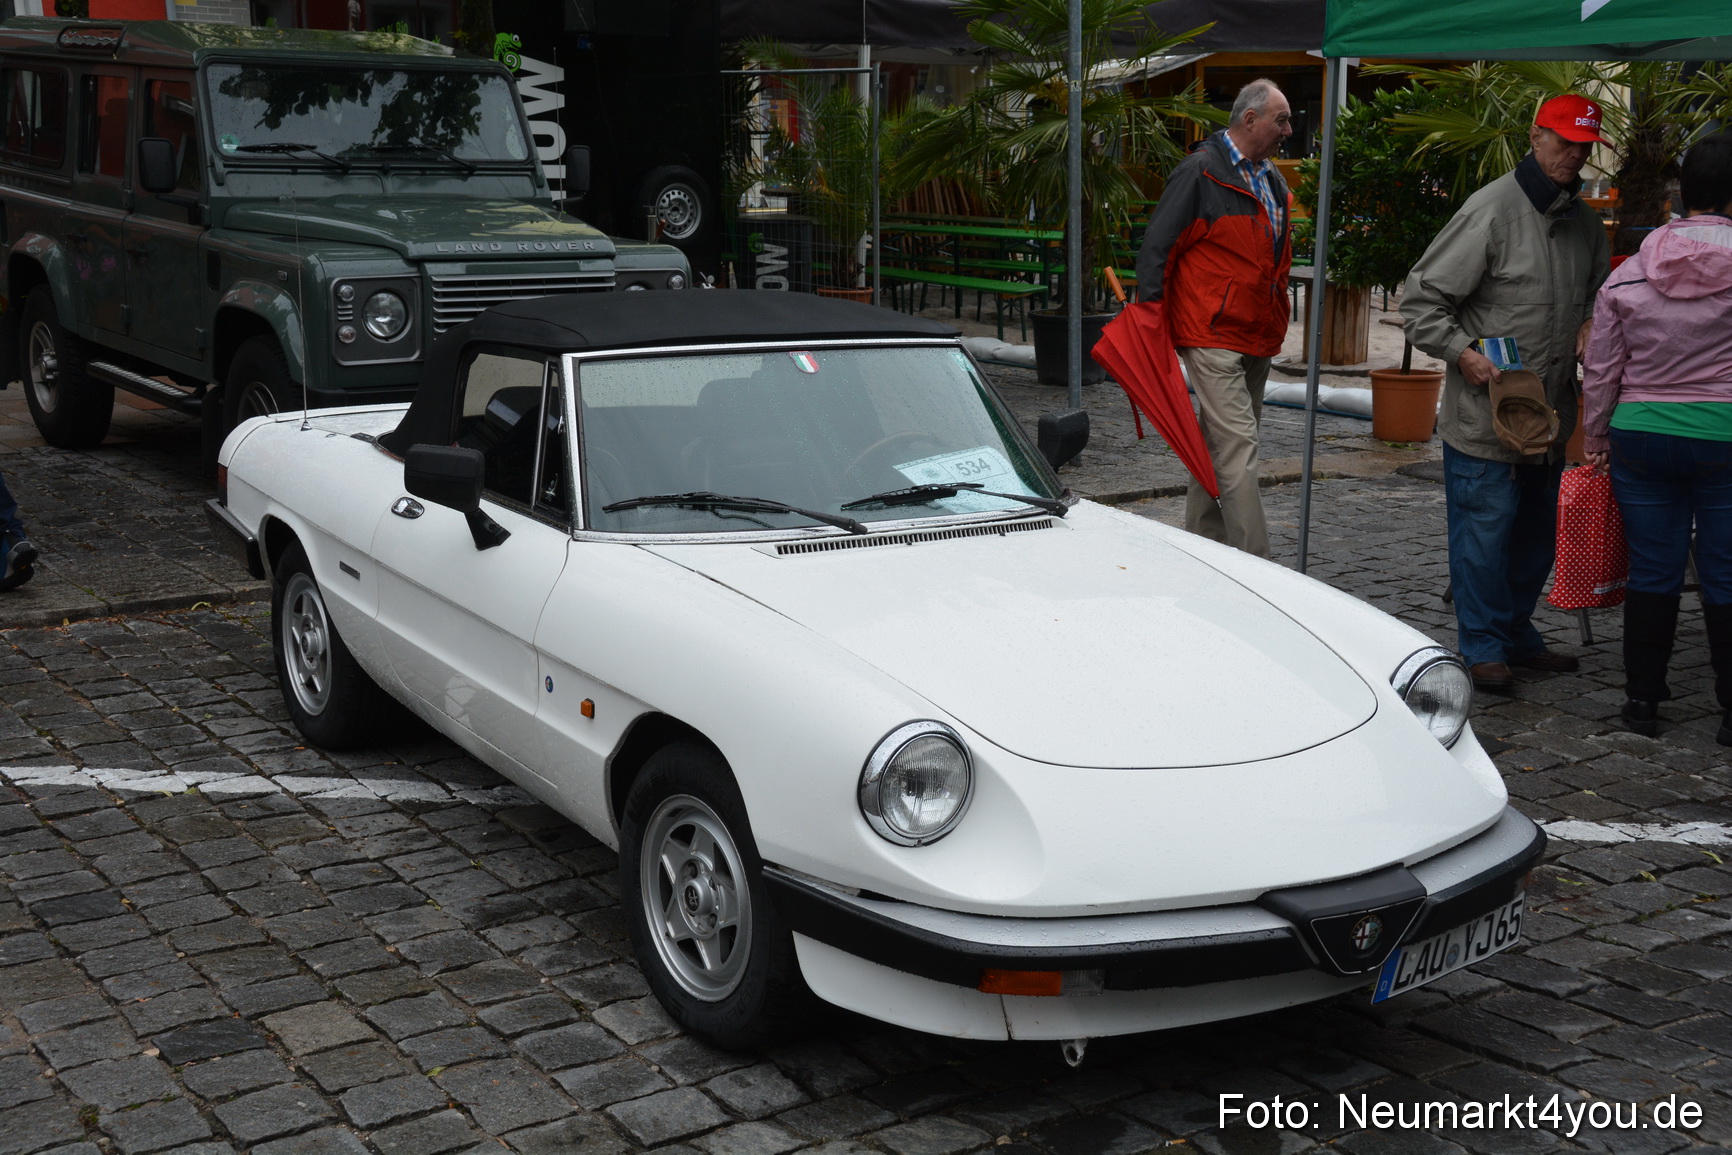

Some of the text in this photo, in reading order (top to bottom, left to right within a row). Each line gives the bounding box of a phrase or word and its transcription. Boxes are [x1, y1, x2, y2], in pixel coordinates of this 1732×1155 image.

[435, 240, 596, 253] LAND ROVER
[955, 457, 991, 477] 534
[1393, 932, 1451, 991] LAU
[1380, 980, 1388, 992] D
